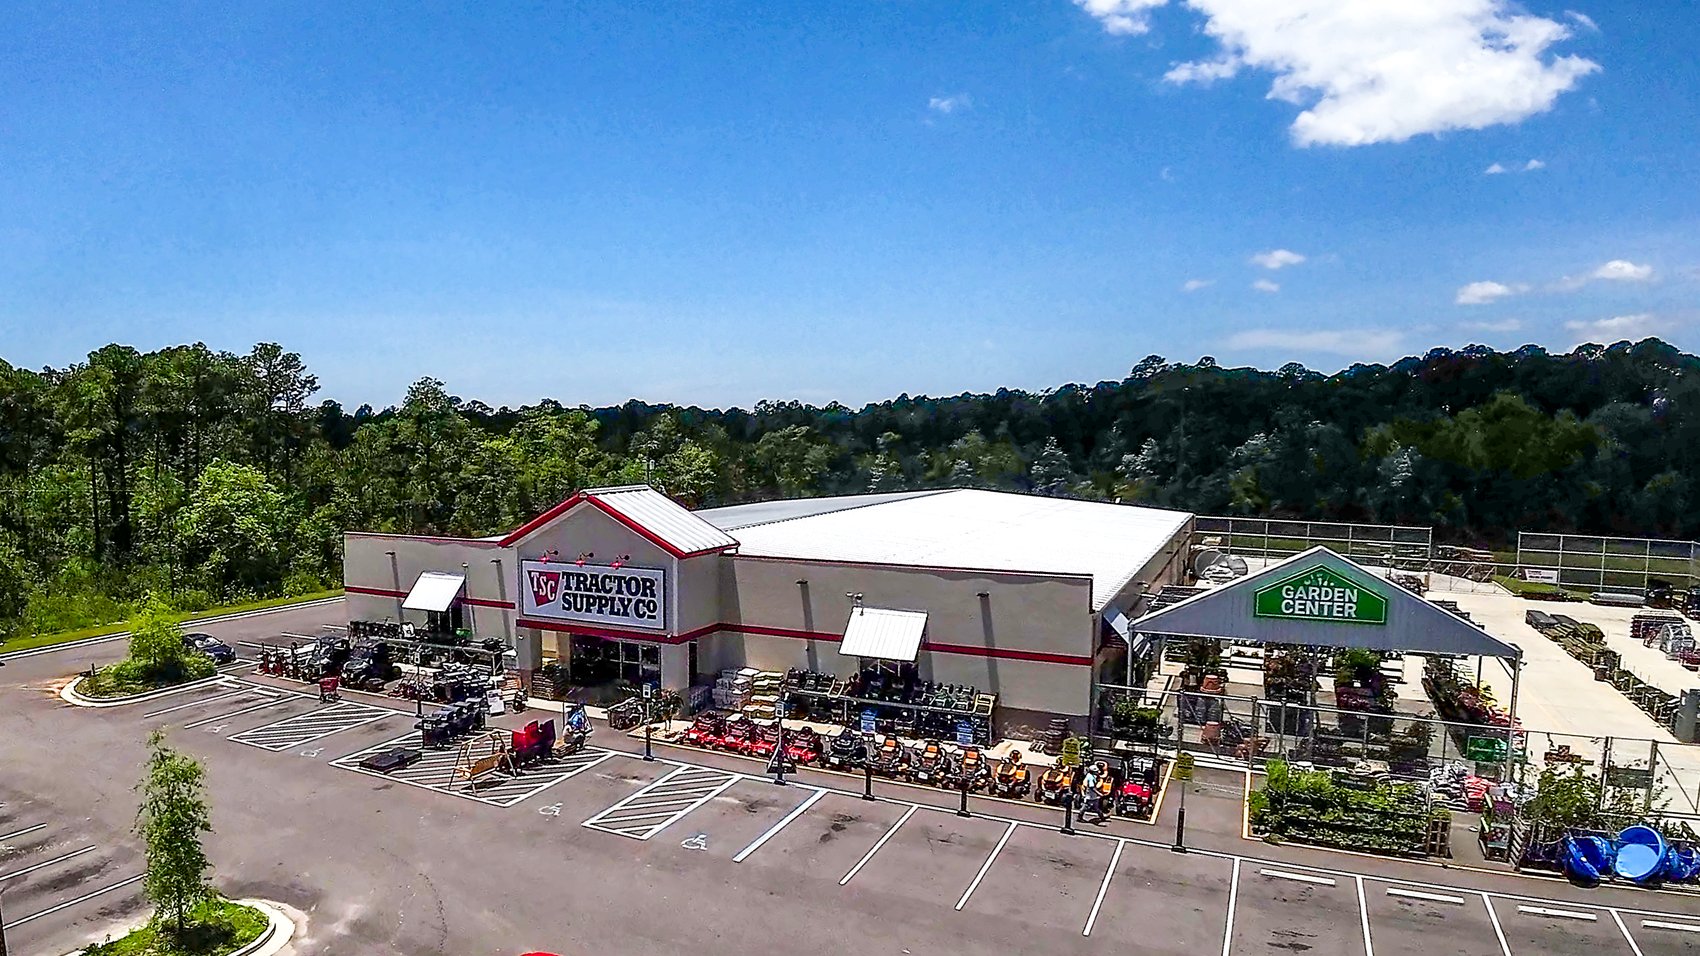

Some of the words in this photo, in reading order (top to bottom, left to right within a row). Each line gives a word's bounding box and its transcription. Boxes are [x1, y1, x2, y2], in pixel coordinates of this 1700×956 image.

[531, 572, 556, 601] TSC
[562, 572, 657, 598] TRACTOR
[1282, 585, 1358, 602] GARDEN
[562, 593, 633, 617] SUPPLY
[1282, 600, 1357, 617] CENTER
